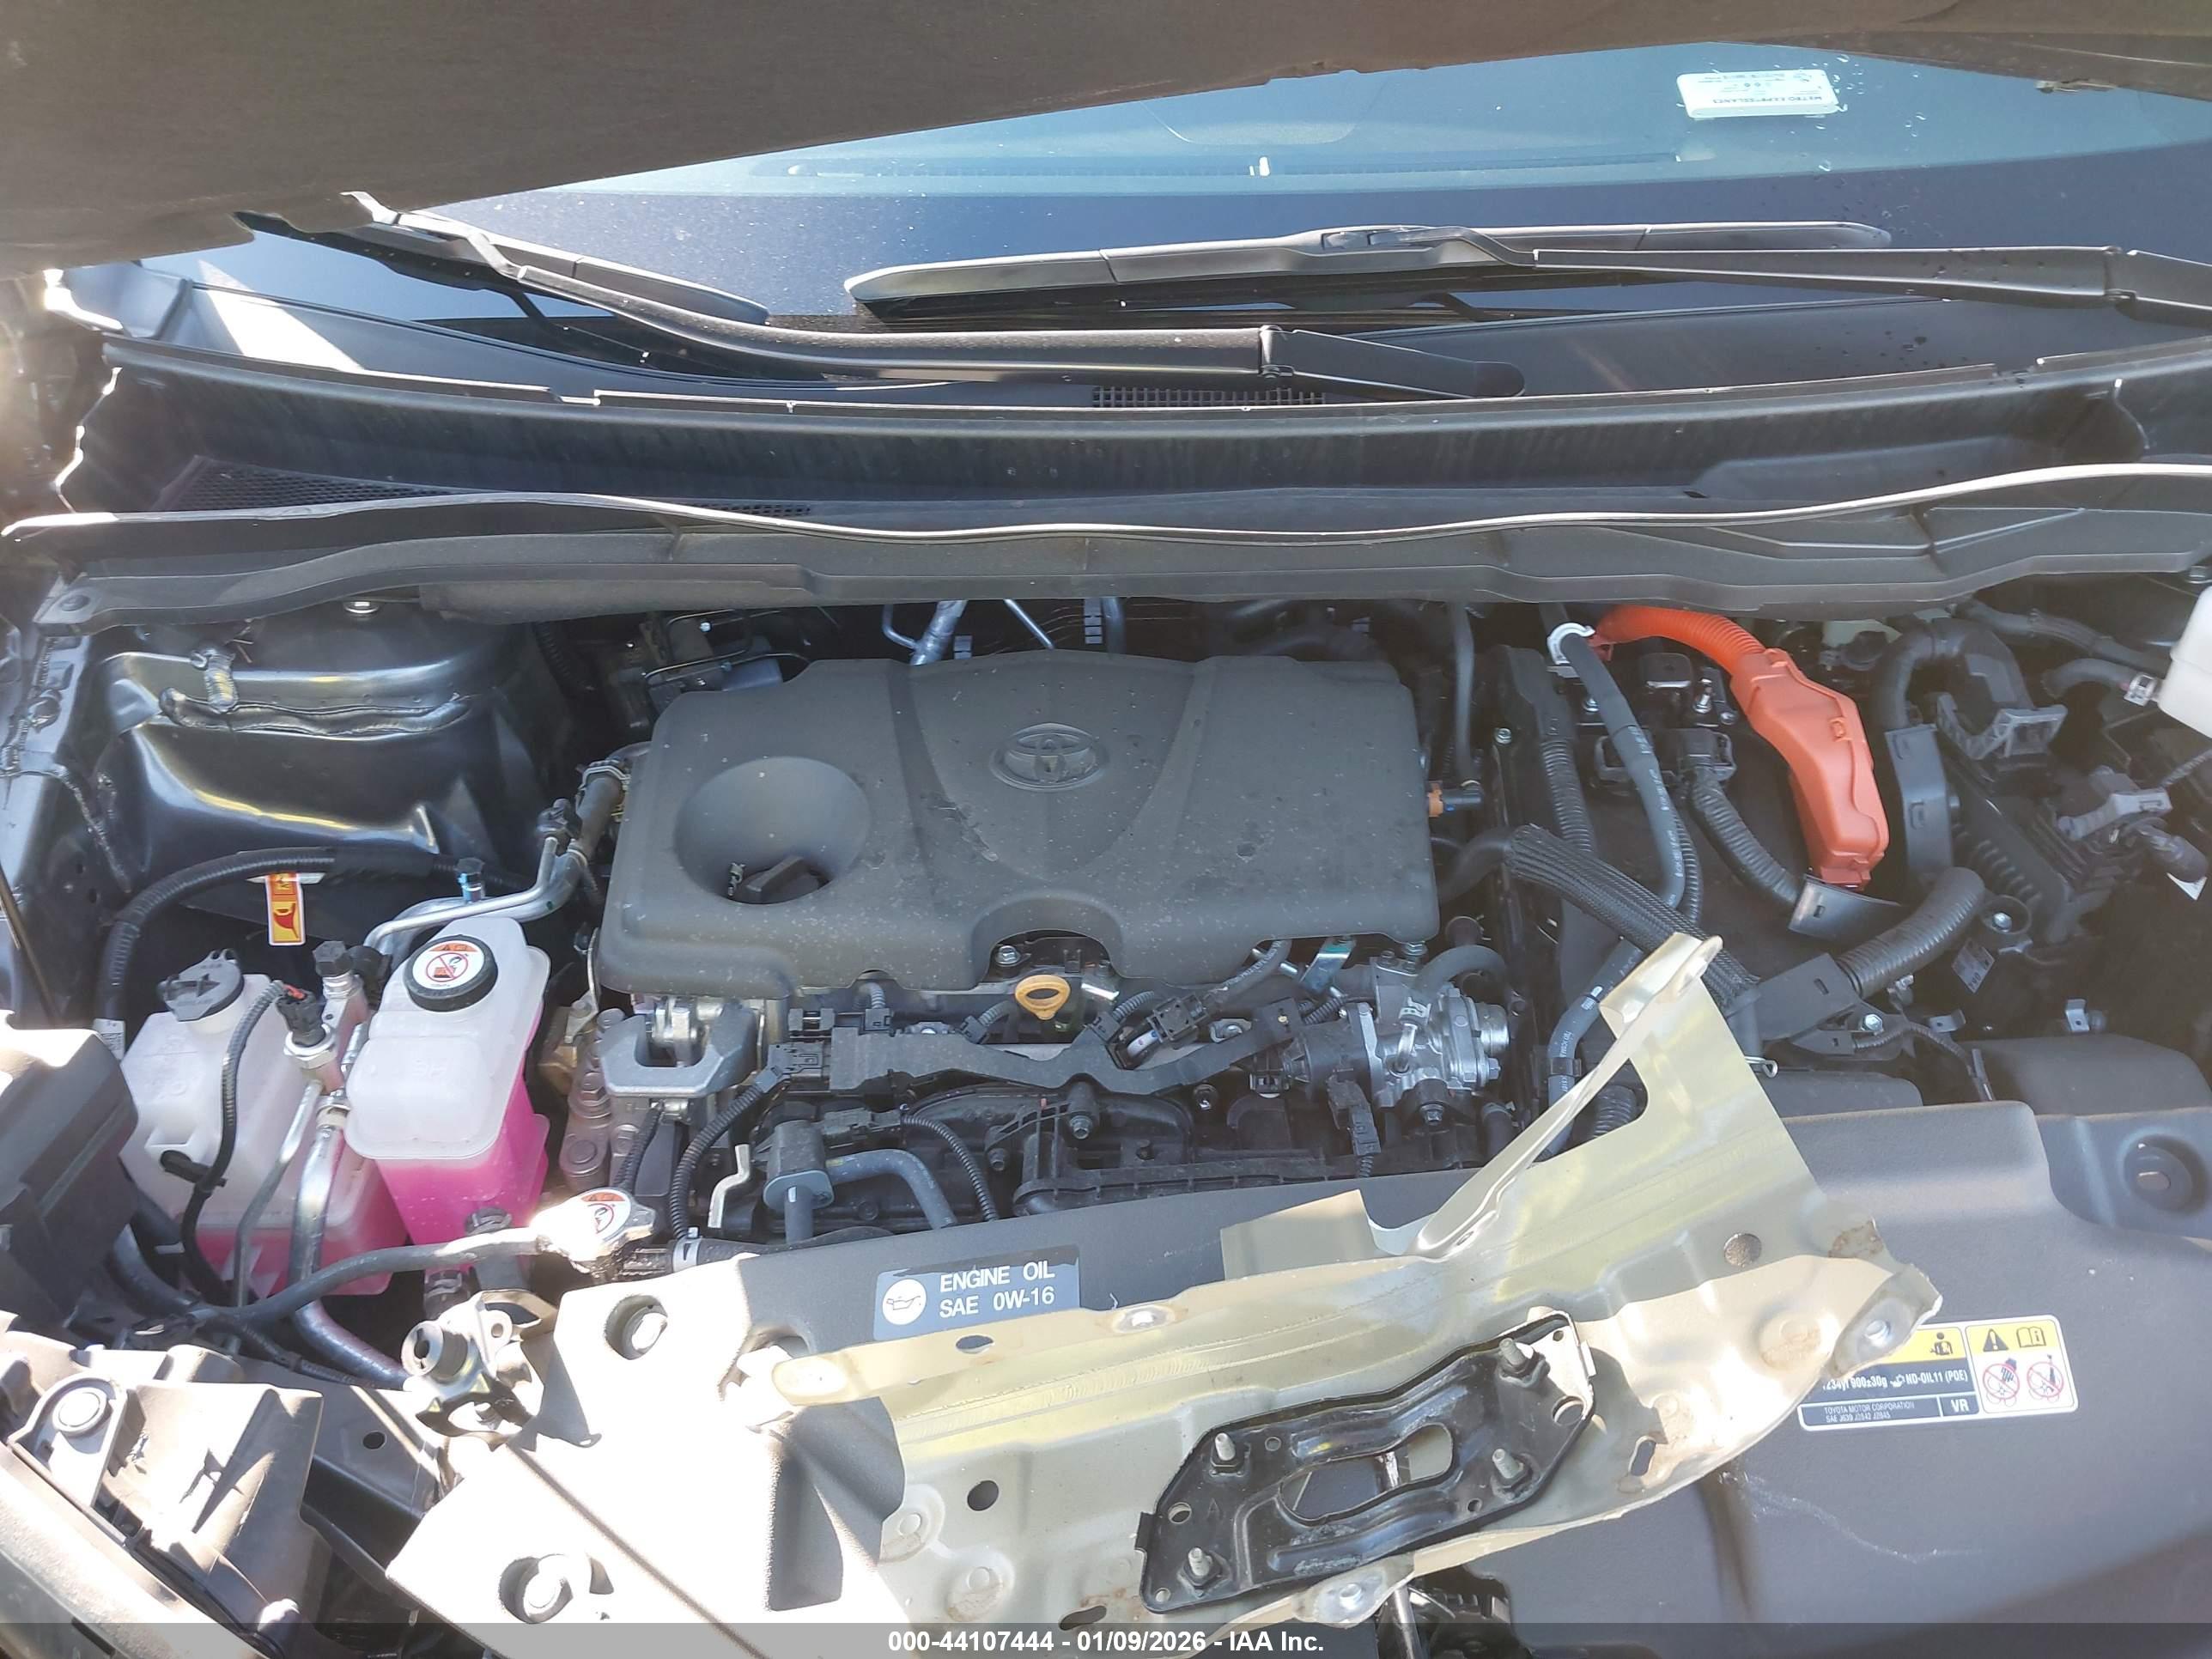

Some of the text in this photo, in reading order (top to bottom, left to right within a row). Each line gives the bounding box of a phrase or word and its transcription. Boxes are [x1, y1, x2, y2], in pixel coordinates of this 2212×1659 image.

[939, 1260, 1055, 1292] ENGINE OIL
[939, 1285, 1055, 1318] SAE 0W-16
[1850, 1376, 1887, 1389] 900±30g
[1905, 1370, 1943, 1384] ND-OIL11
[1945, 1369, 1969, 1383] (POE)
[1824, 1401, 1915, 1415] TOYOTA MOTOR CORPORATION
[1950, 1398, 1970, 1413] VR
[1826, 1414, 1838, 1423] SAE
